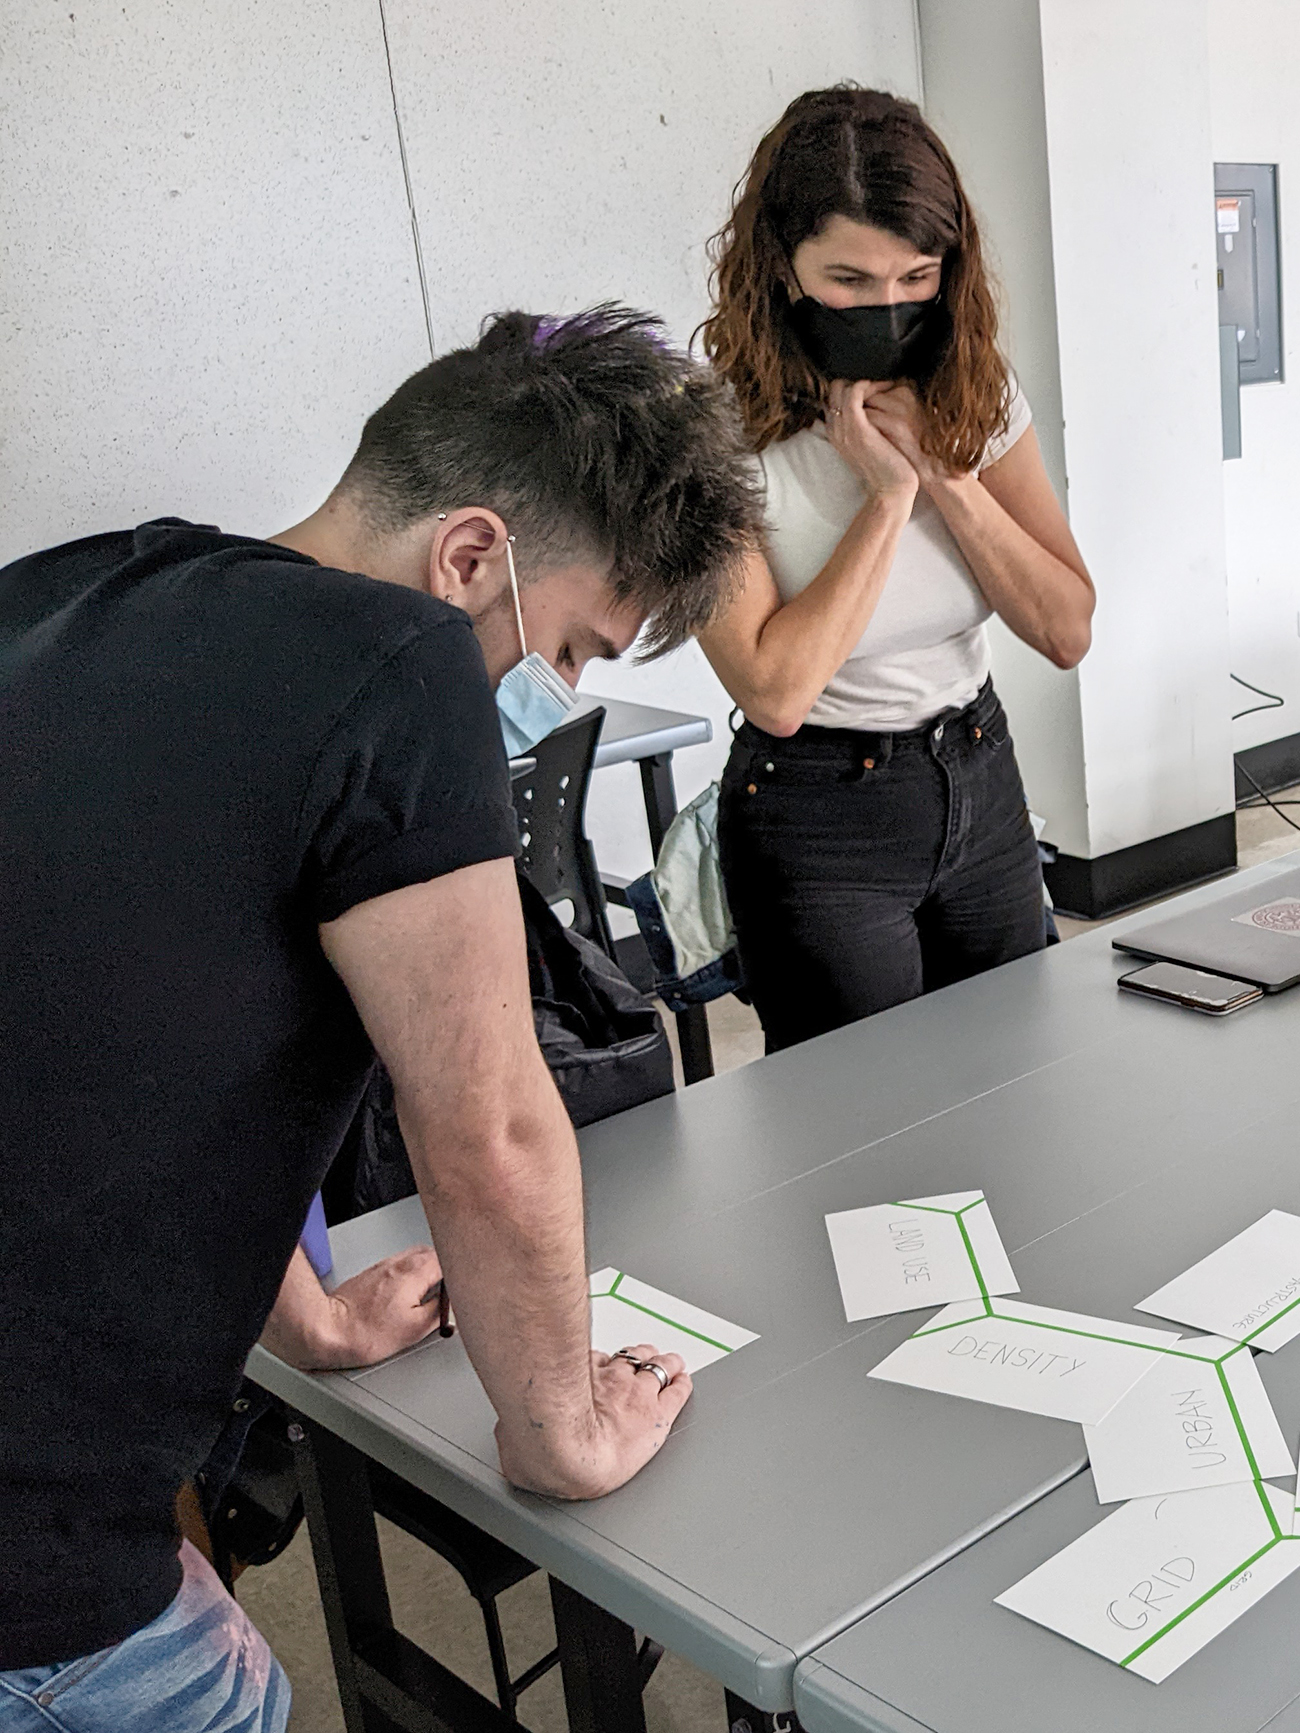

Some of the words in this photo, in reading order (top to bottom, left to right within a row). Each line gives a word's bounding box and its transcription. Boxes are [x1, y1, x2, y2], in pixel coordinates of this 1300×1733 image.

[888, 1218, 924, 1252] LAND
[902, 1256, 931, 1285] USE
[947, 1335, 1087, 1377] DENSITY
[1170, 1388, 1227, 1469] URBAN
[1106, 1556, 1195, 1631] GRID
